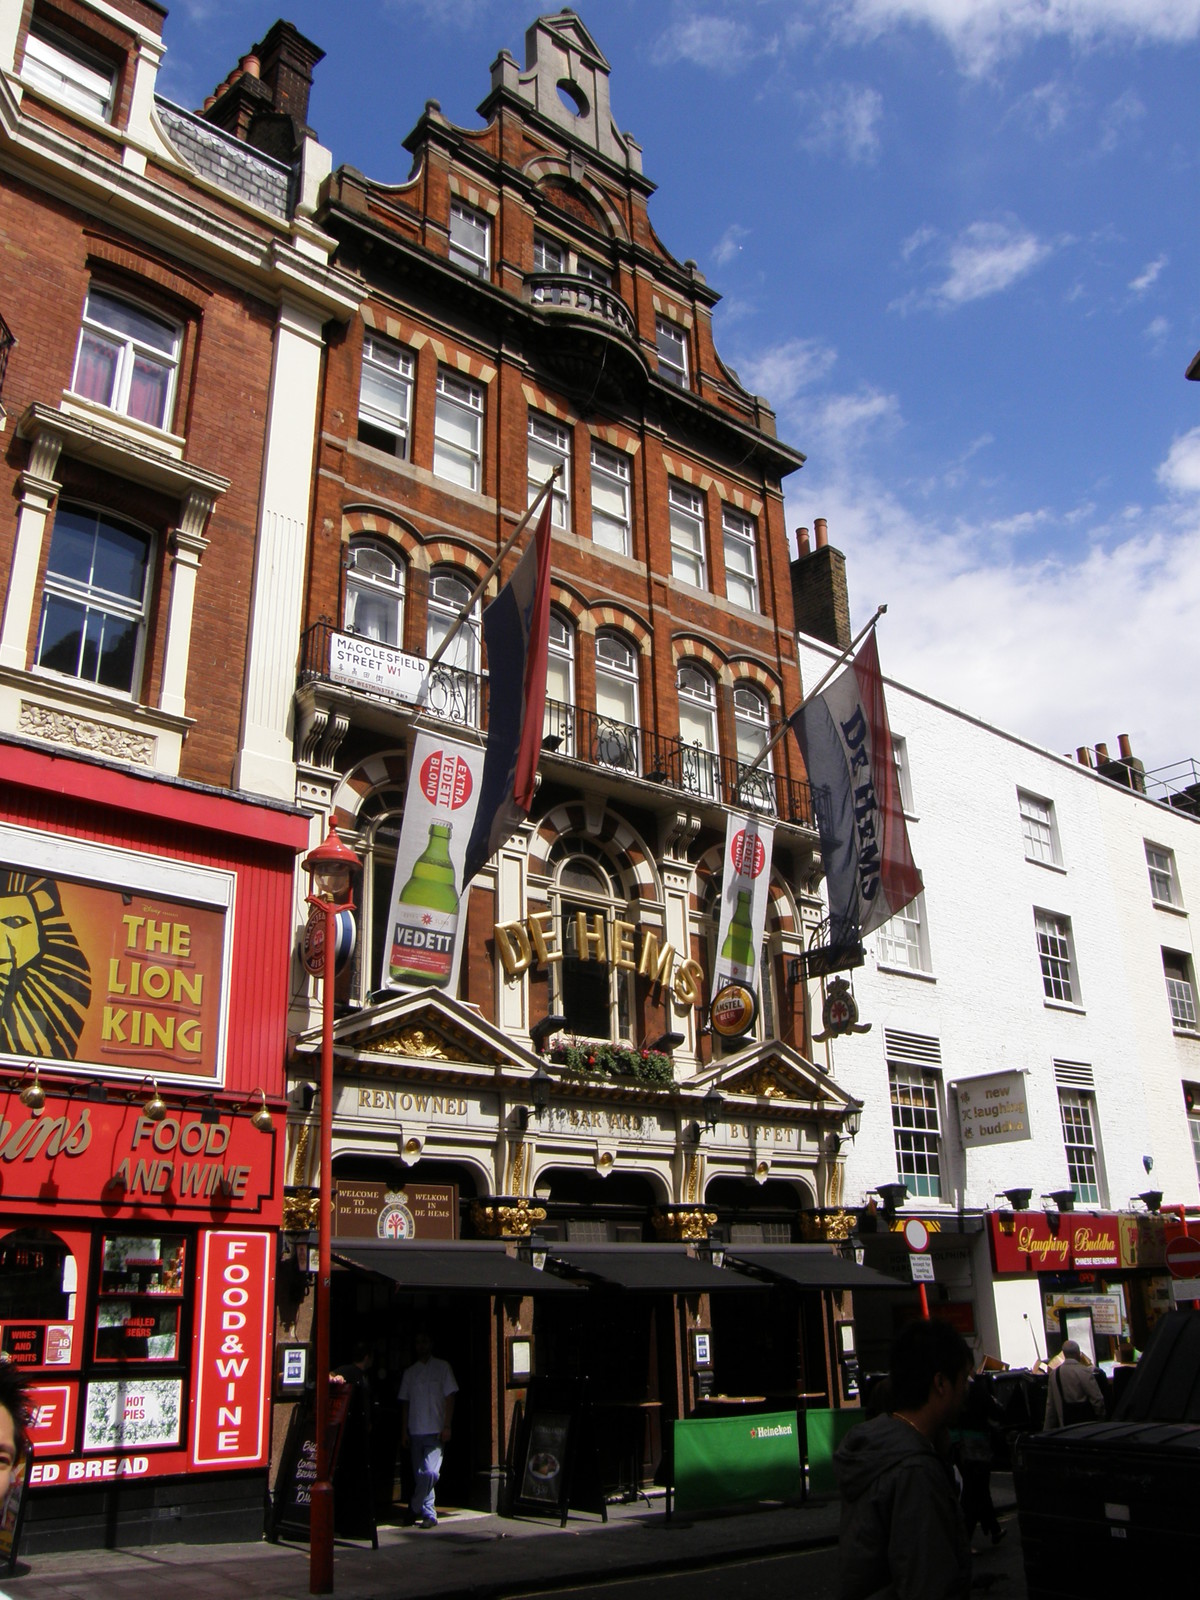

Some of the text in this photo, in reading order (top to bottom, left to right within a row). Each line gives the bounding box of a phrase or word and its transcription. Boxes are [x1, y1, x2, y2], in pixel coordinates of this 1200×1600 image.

[337, 638, 426, 672] MACCLESFIELD
[337, 651, 401, 677] STREET W1
[334, 674, 394, 695] CITY OF WESTMINSTER
[426, 756, 440, 797] BLOND
[439, 756, 455, 808] VEDETT
[454, 764, 467, 804] EXTRA
[841, 704, 880, 900] DE HEMS
[735, 835, 744, 868] BLOND
[743, 833, 754, 877] VEDETT
[753, 841, 762, 874] EXTRA
[122, 915, 192, 958] THE
[397, 927, 451, 952] VEDETT
[494, 911, 705, 1003] DE HEMS
[108, 958, 204, 1005] LION
[716, 1000, 742, 1013] AMSTEL
[720, 1012, 736, 1021] BEER
[101, 1006, 202, 1052] KING
[358, 1088, 468, 1116] RENOWNED
[985, 1087, 1010, 1099] new
[569, 1109, 641, 1130] BAR AND
[979, 1120, 1024, 1137] buddha
[131, 1116, 230, 1155] FOOD
[730, 1124, 794, 1143] BUFFET
[109, 1157, 251, 1197] AND WINE
[339, 1190, 380, 1199] WELCOME
[353, 1199, 365, 1207] TO
[415, 1193, 449, 1202] WELKOM
[340, 1207, 378, 1216] DE HEMS
[414, 1210, 450, 1218] DE HEMS
[427, 1202, 436, 1210] IN
[1018, 1226, 1069, 1262] Laughing
[1074, 1227, 1115, 1252] Buddha
[1075, 1257, 1118, 1266] CHINESE RESTAURANT
[123, 1317, 155, 1327] CHILLED
[125, 1328, 151, 1337] BEERS
[11, 1330, 37, 1340] WINES
[15, 1341, 31, 1351] AND
[126, 1396, 145, 1407] HOT
[123, 1409, 145, 1420] PIES
[757, 1424, 792, 1438] Heineken
[68, 1457, 149, 1479] BREAD
